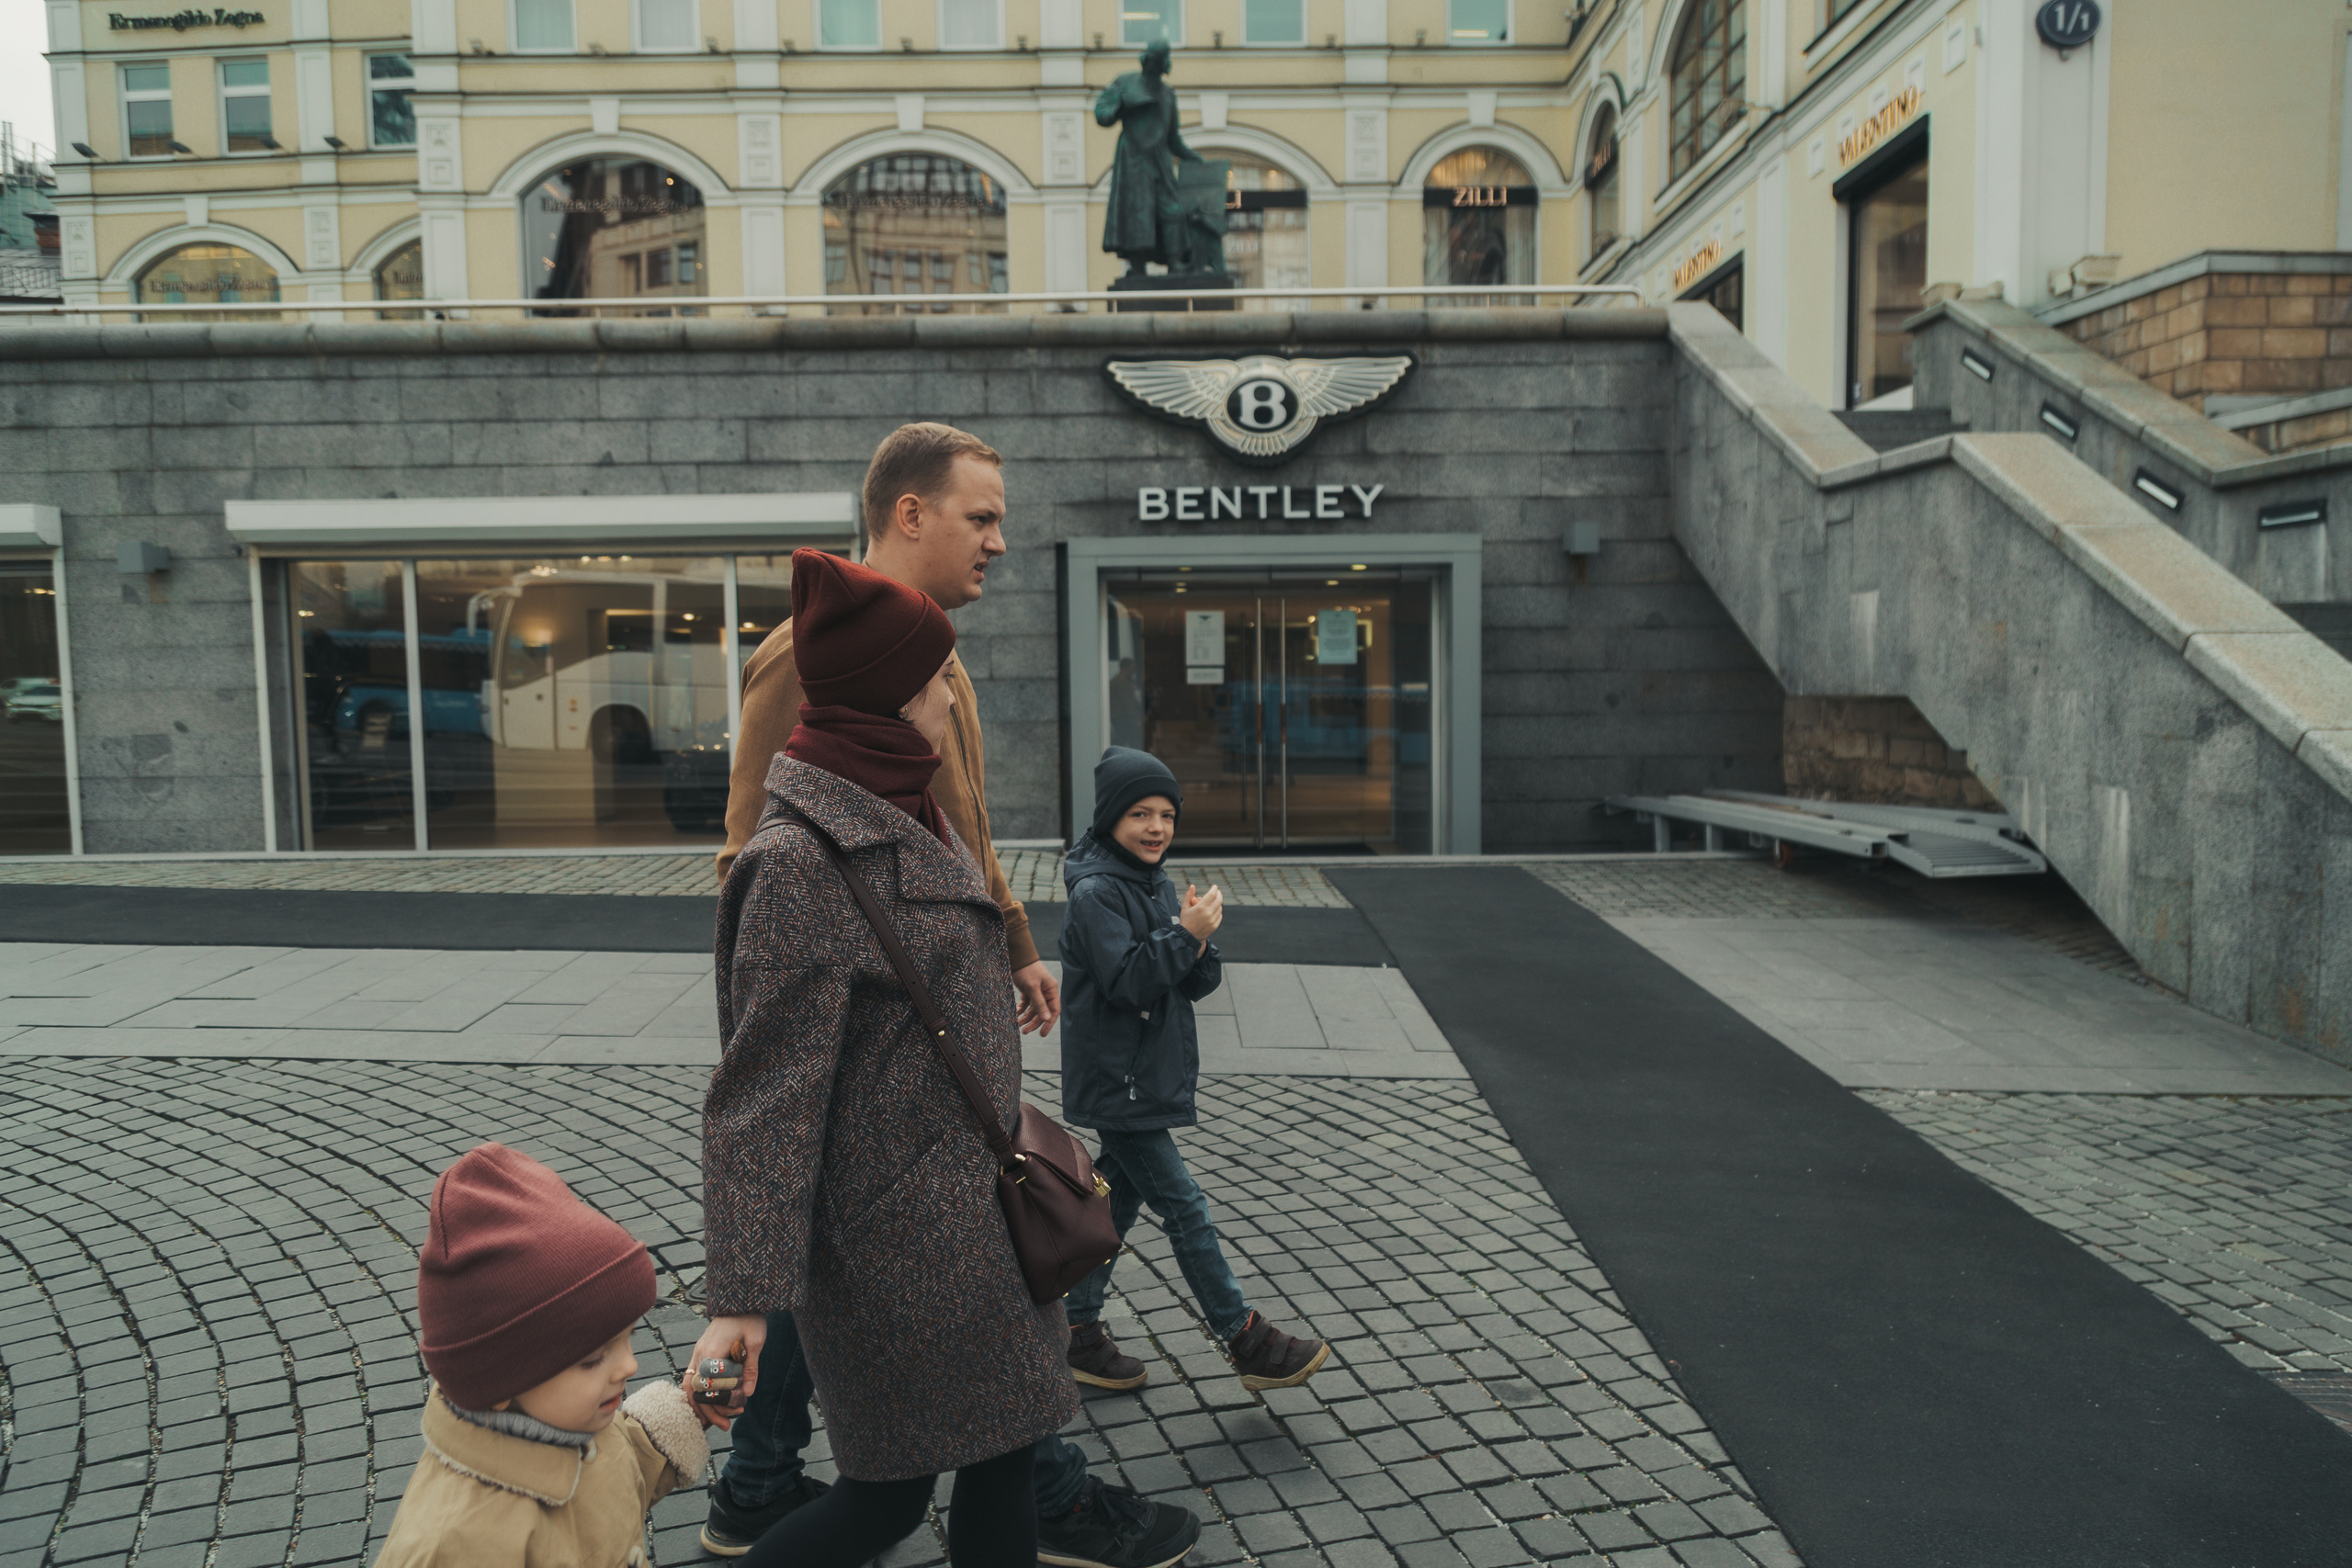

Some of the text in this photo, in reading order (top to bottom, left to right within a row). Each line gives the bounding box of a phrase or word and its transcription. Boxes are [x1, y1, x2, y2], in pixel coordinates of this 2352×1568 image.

[108, 8, 266, 32] Ermenegildo Zegna
[2054, 1, 2090, 35] 1/1
[1838, 85, 1920, 166] VALENTINO
[1453, 186, 1508, 208] ZILLI
[1674, 240, 1722, 290] VALENTINO
[1238, 380, 1287, 428] B
[1138, 484, 1385, 520] BENTLEY
